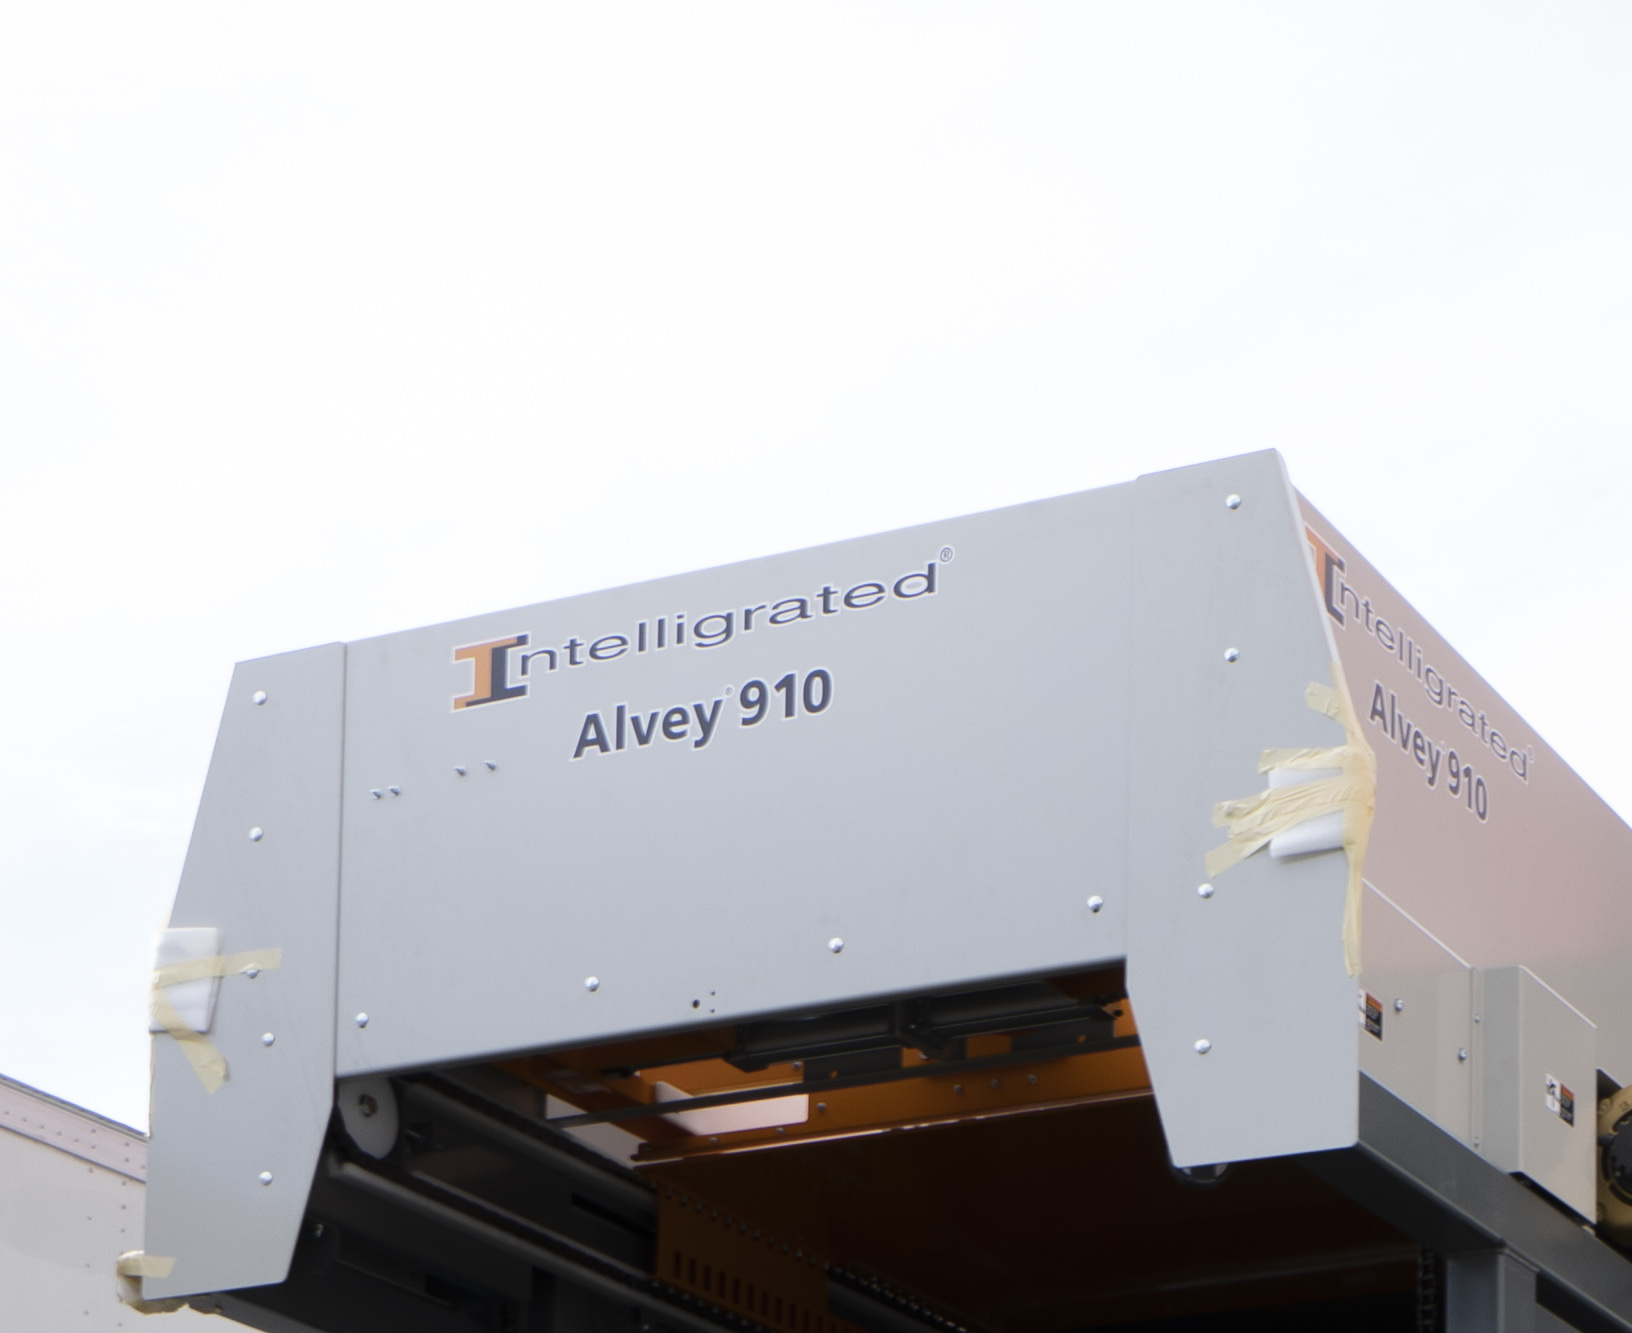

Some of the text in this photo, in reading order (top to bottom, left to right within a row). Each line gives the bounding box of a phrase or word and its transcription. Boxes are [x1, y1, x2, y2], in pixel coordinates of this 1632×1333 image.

[453, 562, 937, 710] Intelligrated
[573, 668, 832, 760] Alvey 910
[1370, 683, 1488, 822] Alvey 910
